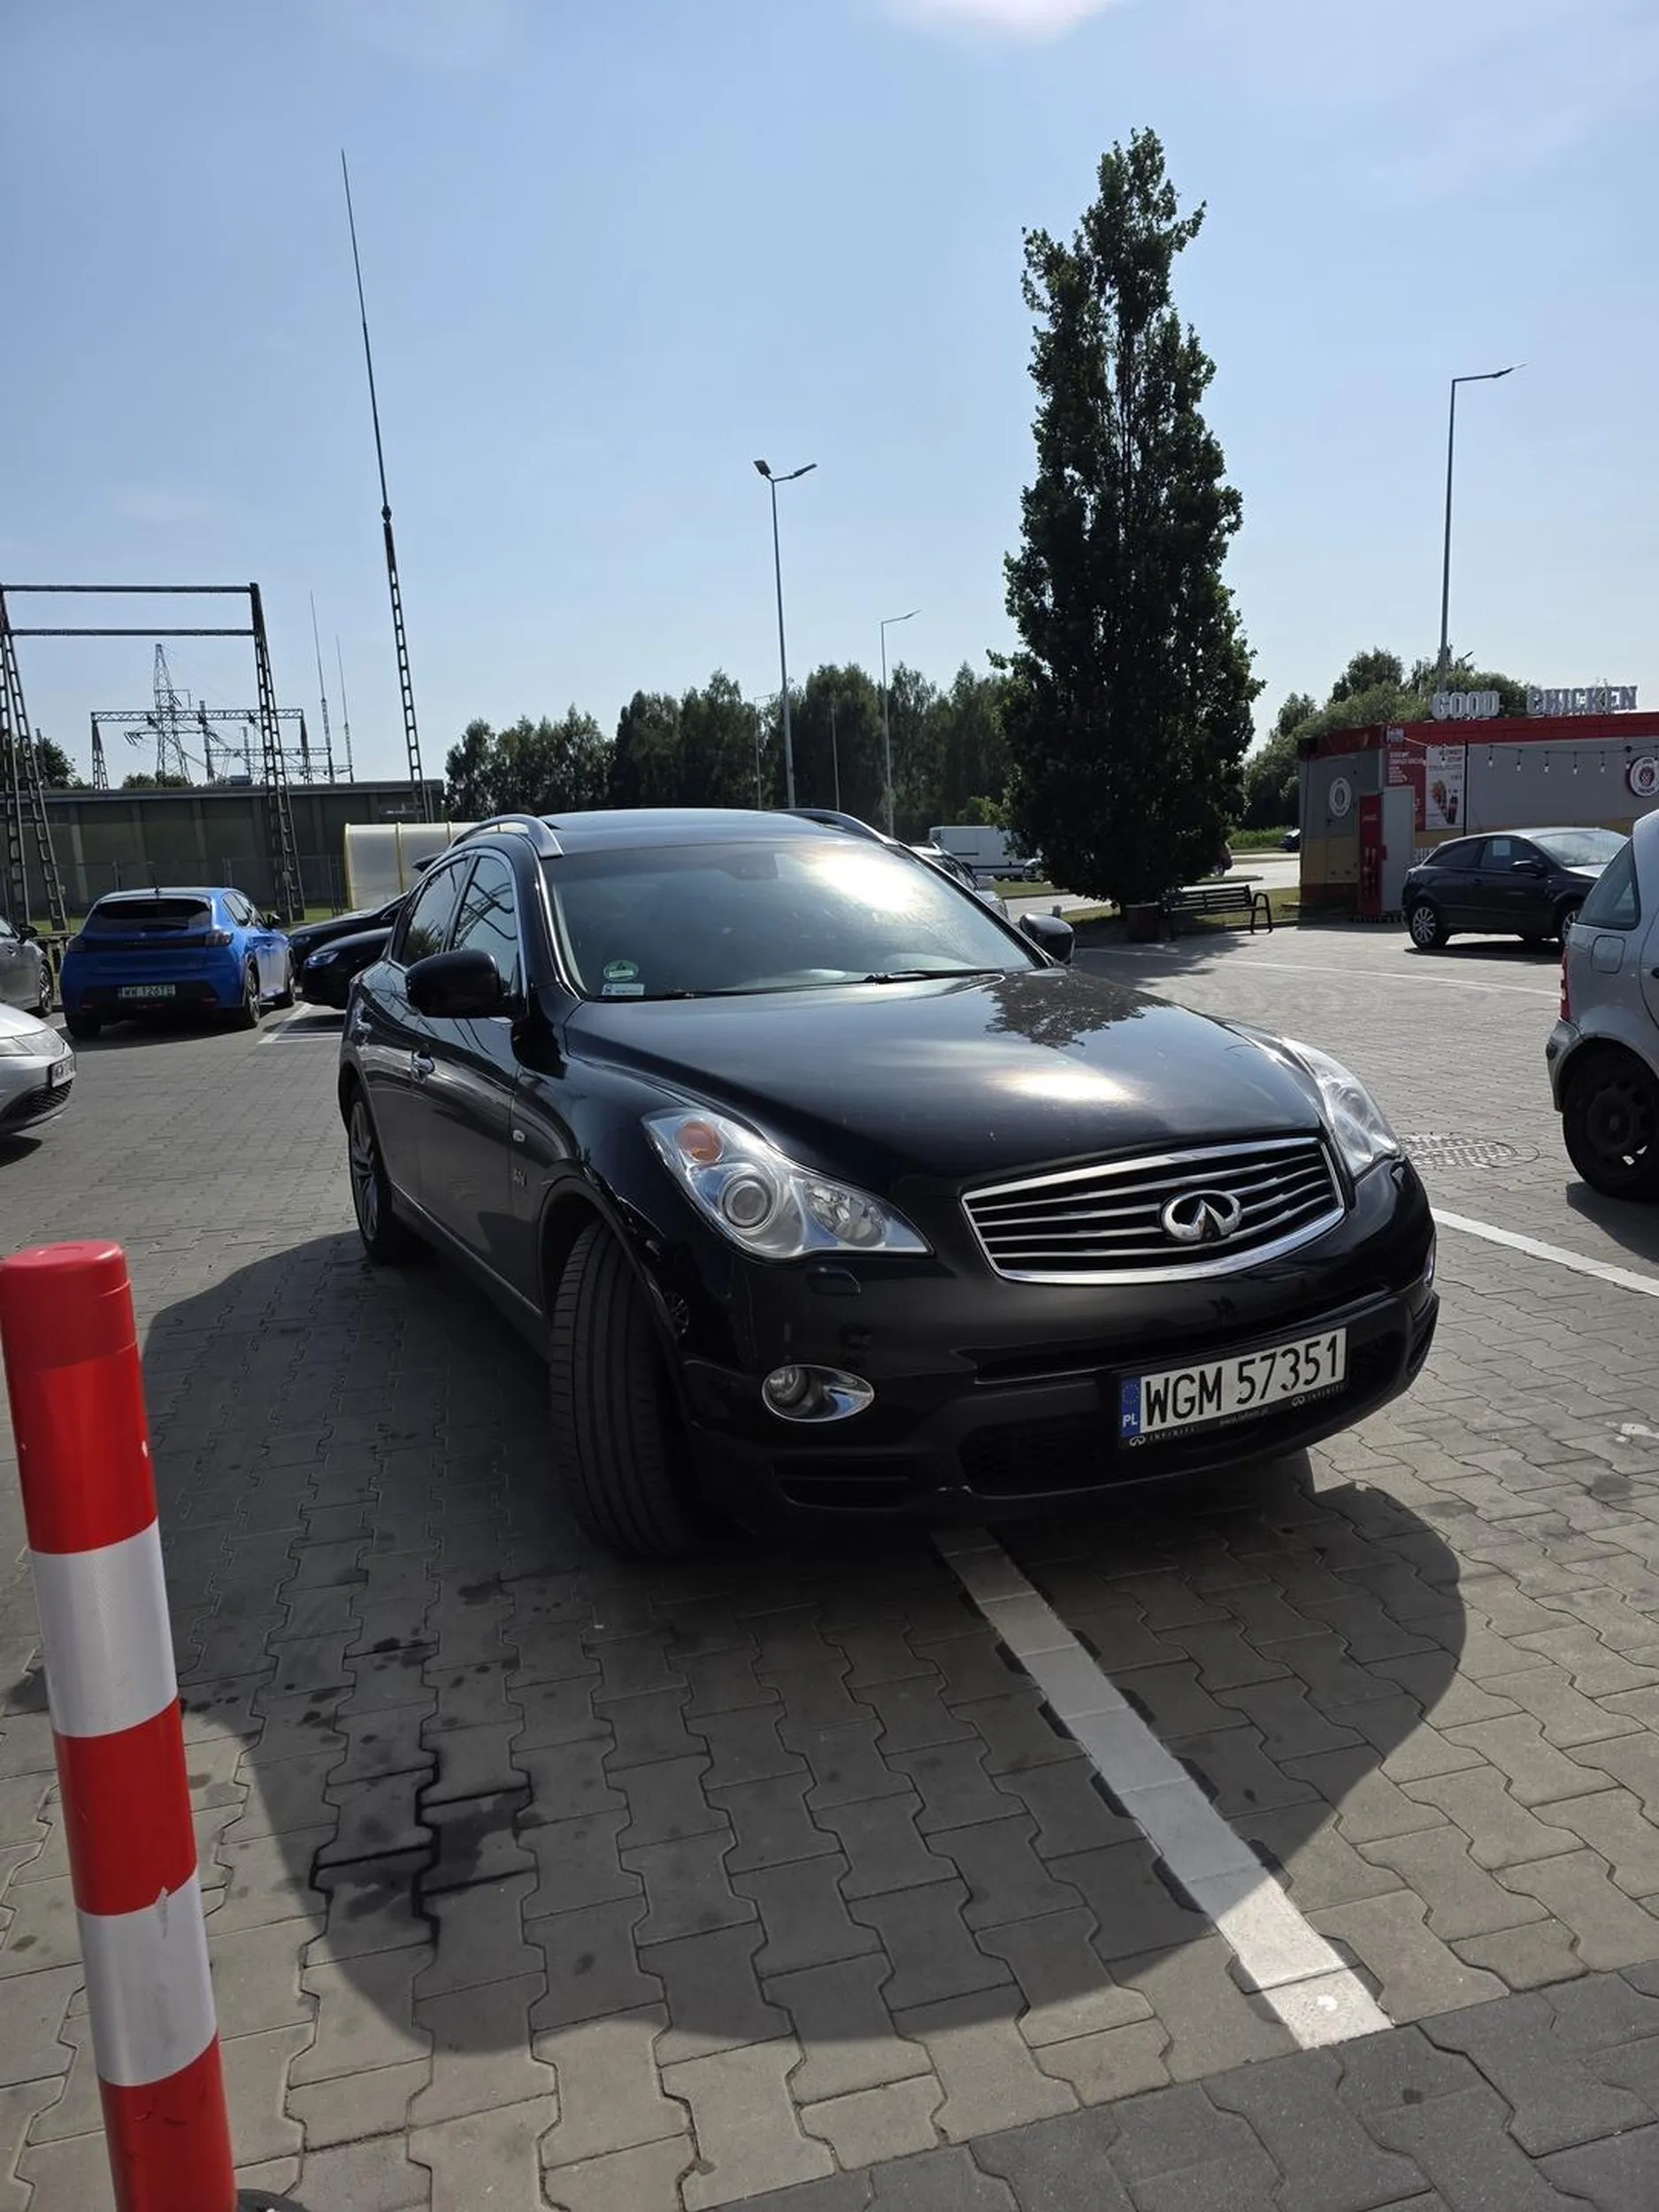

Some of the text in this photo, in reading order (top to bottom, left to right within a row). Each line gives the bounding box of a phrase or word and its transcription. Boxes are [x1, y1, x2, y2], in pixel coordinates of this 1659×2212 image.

[1432, 686, 1638, 719] GOOD CHICKEN
[1146, 1333, 1337, 1426] WGM 57351
[1122, 1413, 1138, 1428] PL
